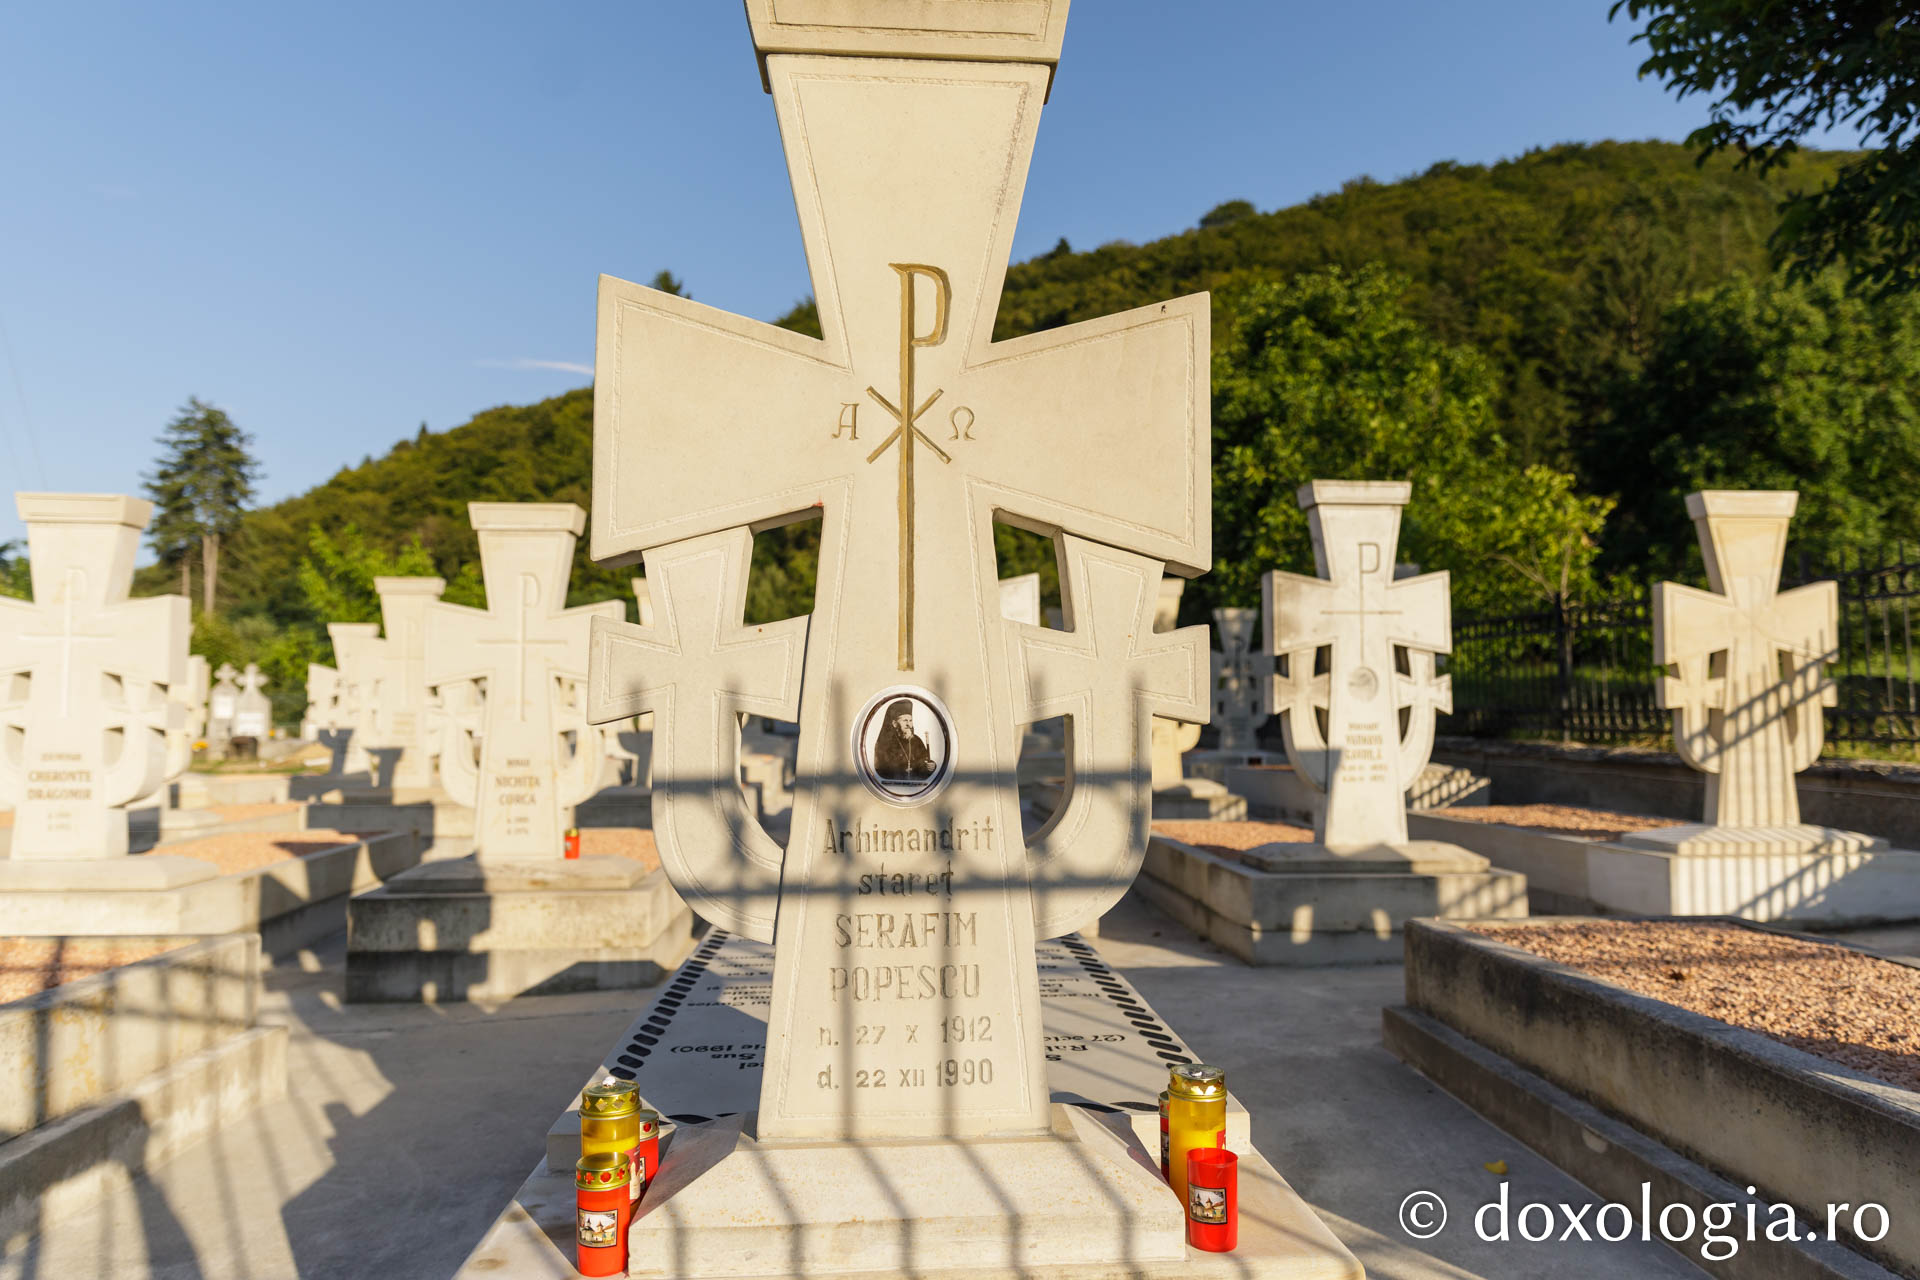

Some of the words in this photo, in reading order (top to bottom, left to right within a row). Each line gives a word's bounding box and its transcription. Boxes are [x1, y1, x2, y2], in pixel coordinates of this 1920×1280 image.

[823, 816, 994, 854] Arhimandrit
[834, 912, 978, 949] SERAFIM
[829, 964, 980, 1002] POPESCU
[818, 1026, 839, 1047] n.
[855, 1025, 886, 1045] 27
[905, 1024, 919, 1044] X
[940, 1015, 993, 1044] 1912
[817, 1064, 839, 1090] d.
[855, 1069, 887, 1089] 22
[899, 1068, 925, 1088] XII
[935, 1057, 993, 1087] 1990
